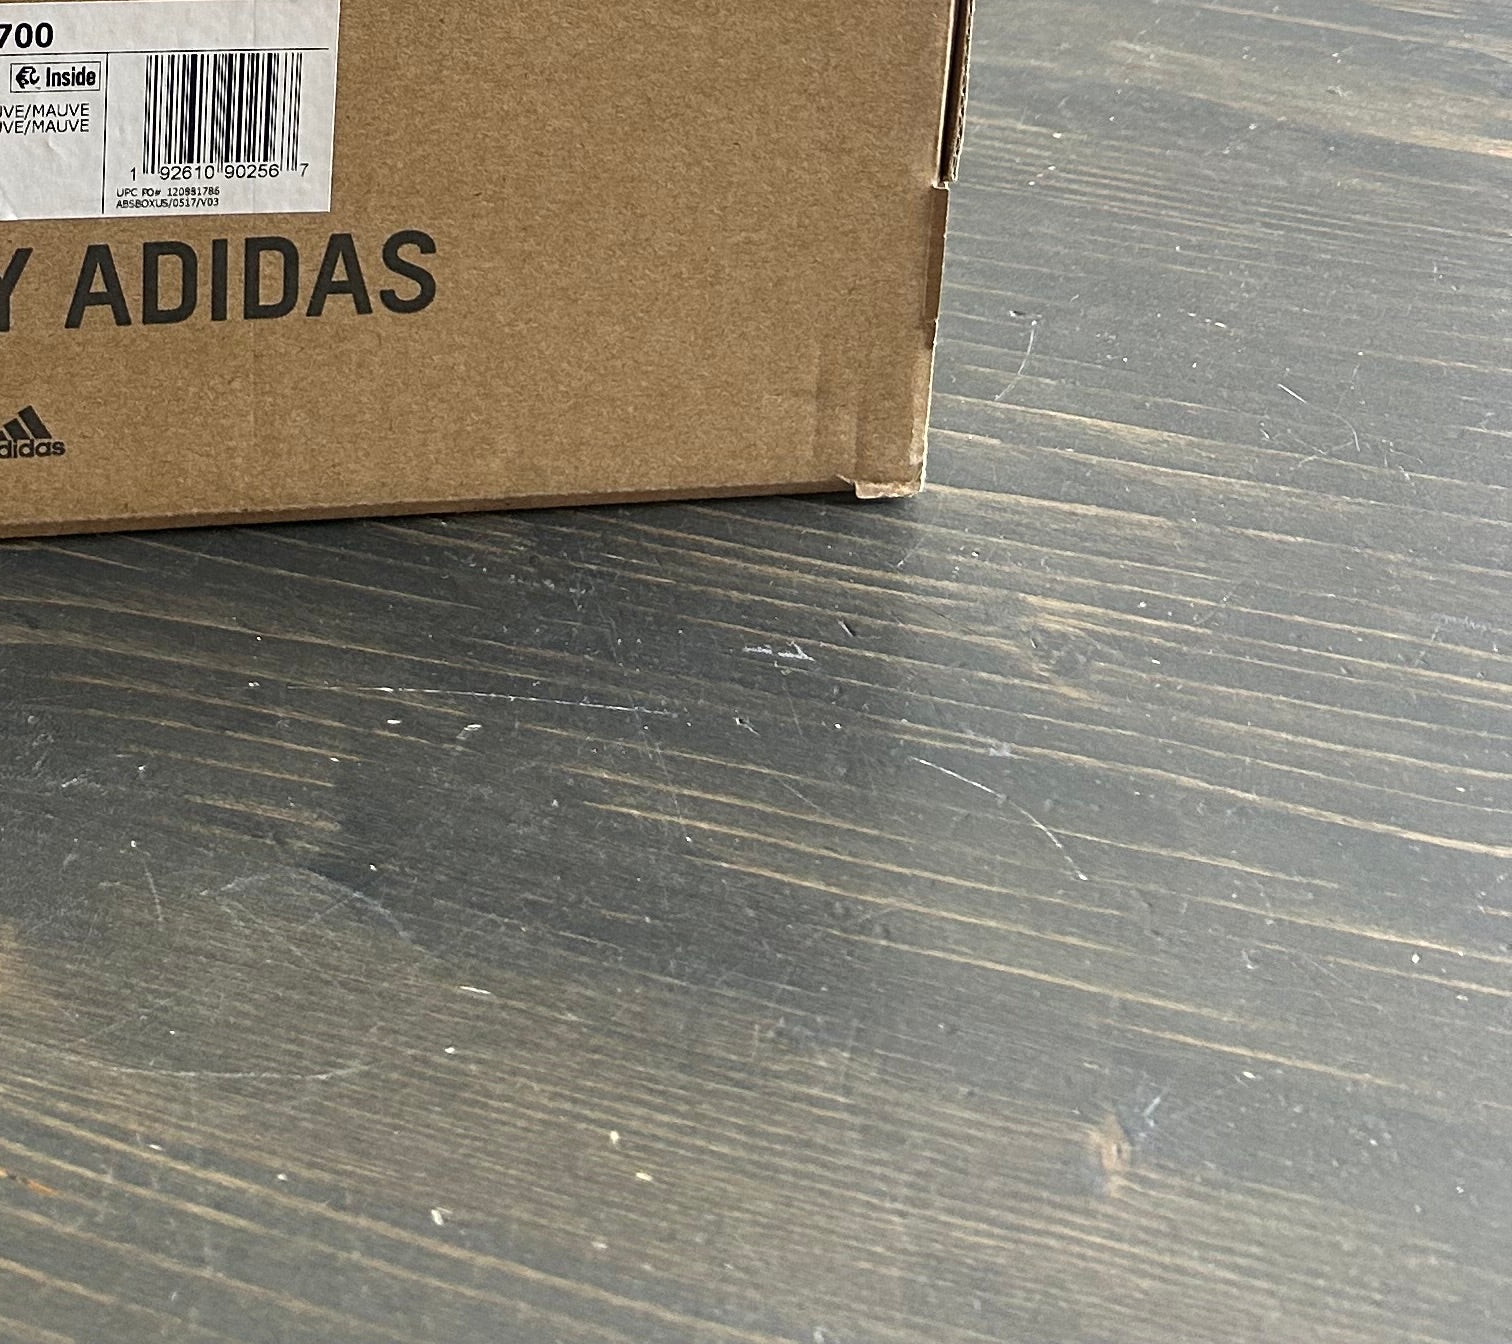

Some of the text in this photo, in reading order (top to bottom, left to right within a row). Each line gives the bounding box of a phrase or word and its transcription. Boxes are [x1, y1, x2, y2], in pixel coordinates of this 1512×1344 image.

[45, 65, 96, 88] Inside
[159, 164, 216, 181] 92610
[224, 163, 281, 180] 90256
[299, 162, 310, 178] 7
[116, 187, 138, 198] UPC
[64, 229, 438, 331] ADIDAS
